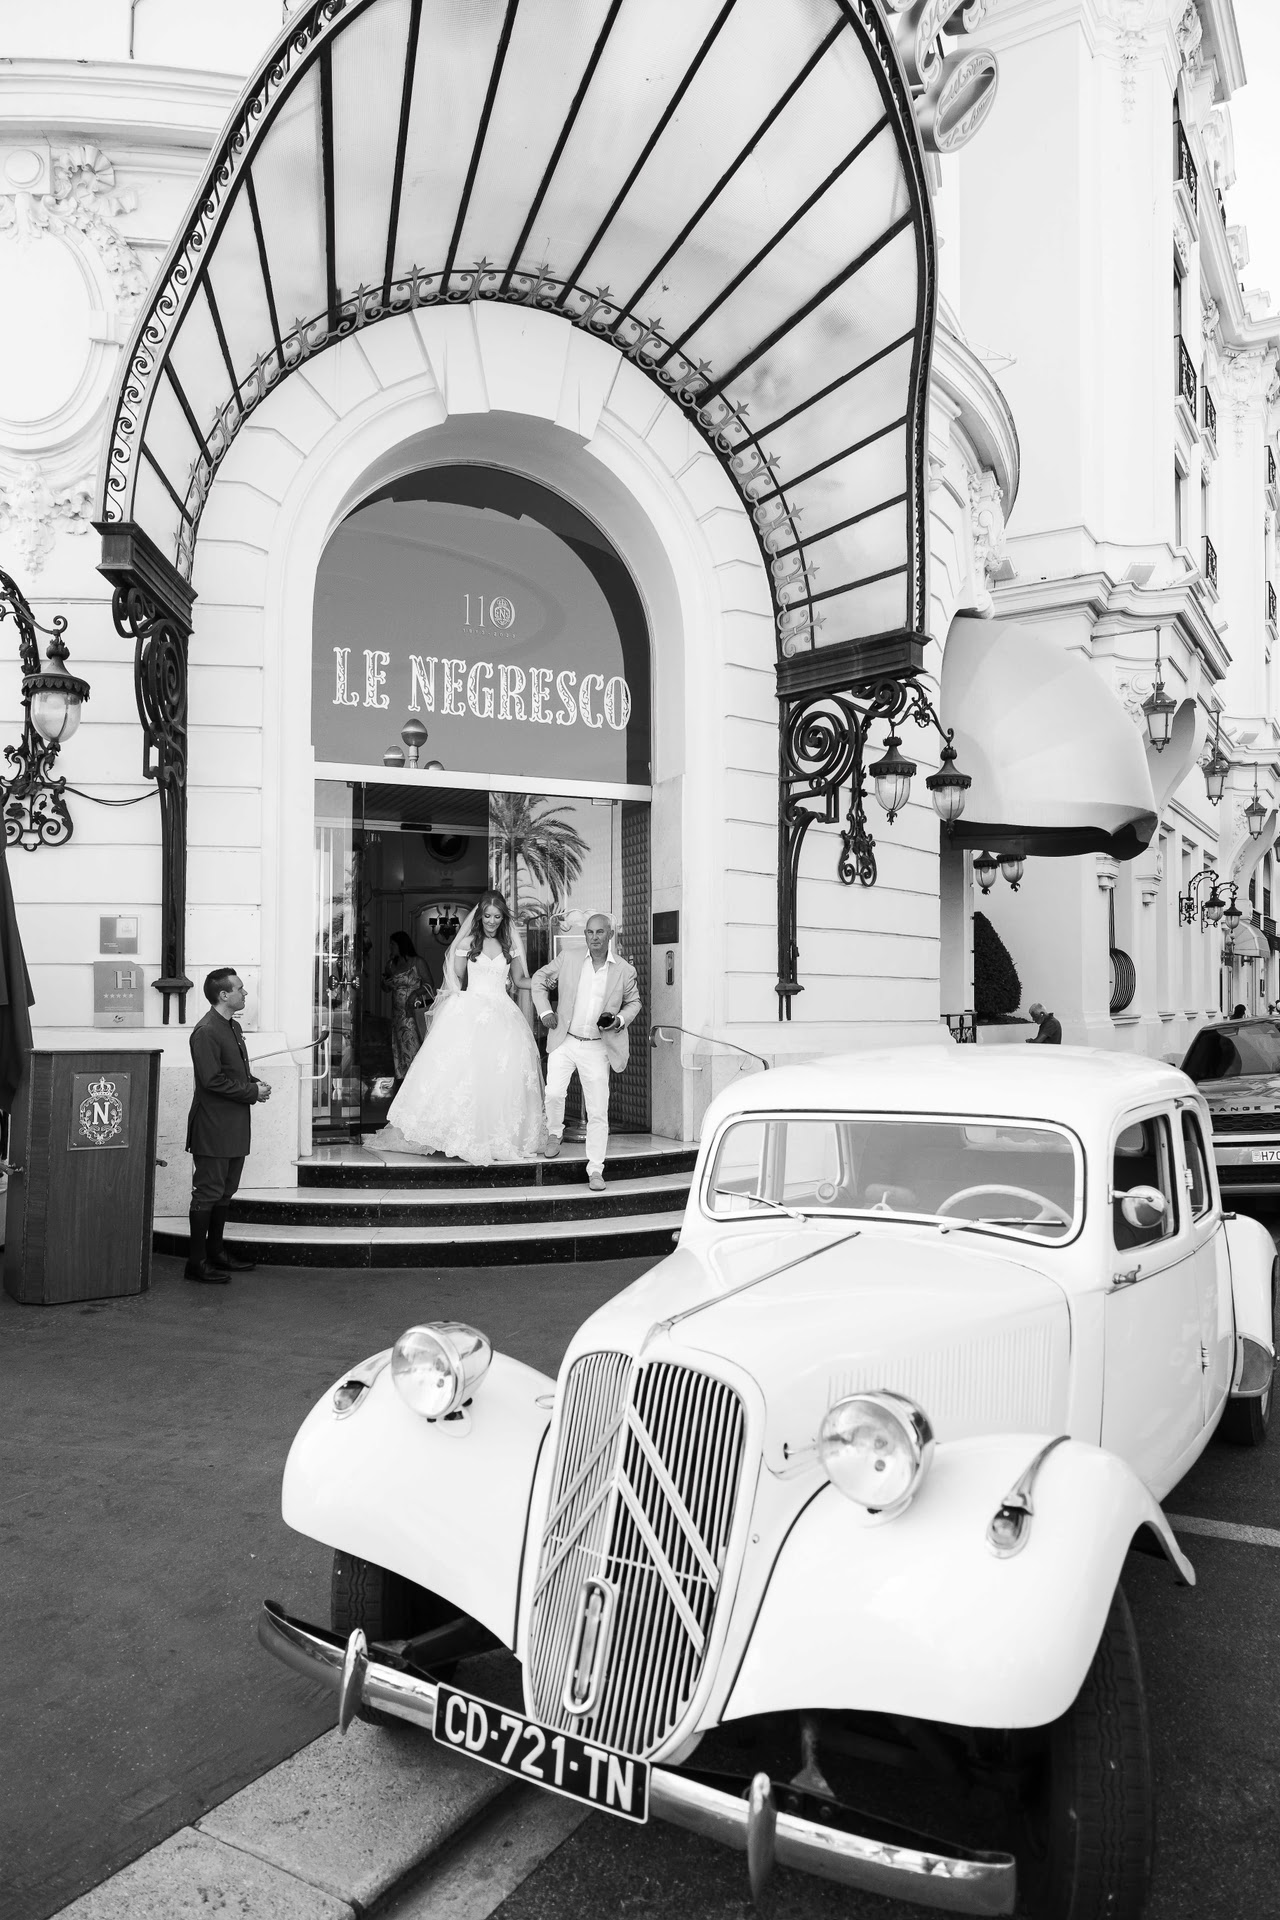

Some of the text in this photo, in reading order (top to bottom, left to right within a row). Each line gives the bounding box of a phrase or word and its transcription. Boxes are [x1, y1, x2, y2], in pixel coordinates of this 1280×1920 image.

[332, 646, 632, 731] LE NEGRESCO
[114, 970, 138, 990] H
[92, 1102, 110, 1125] N
